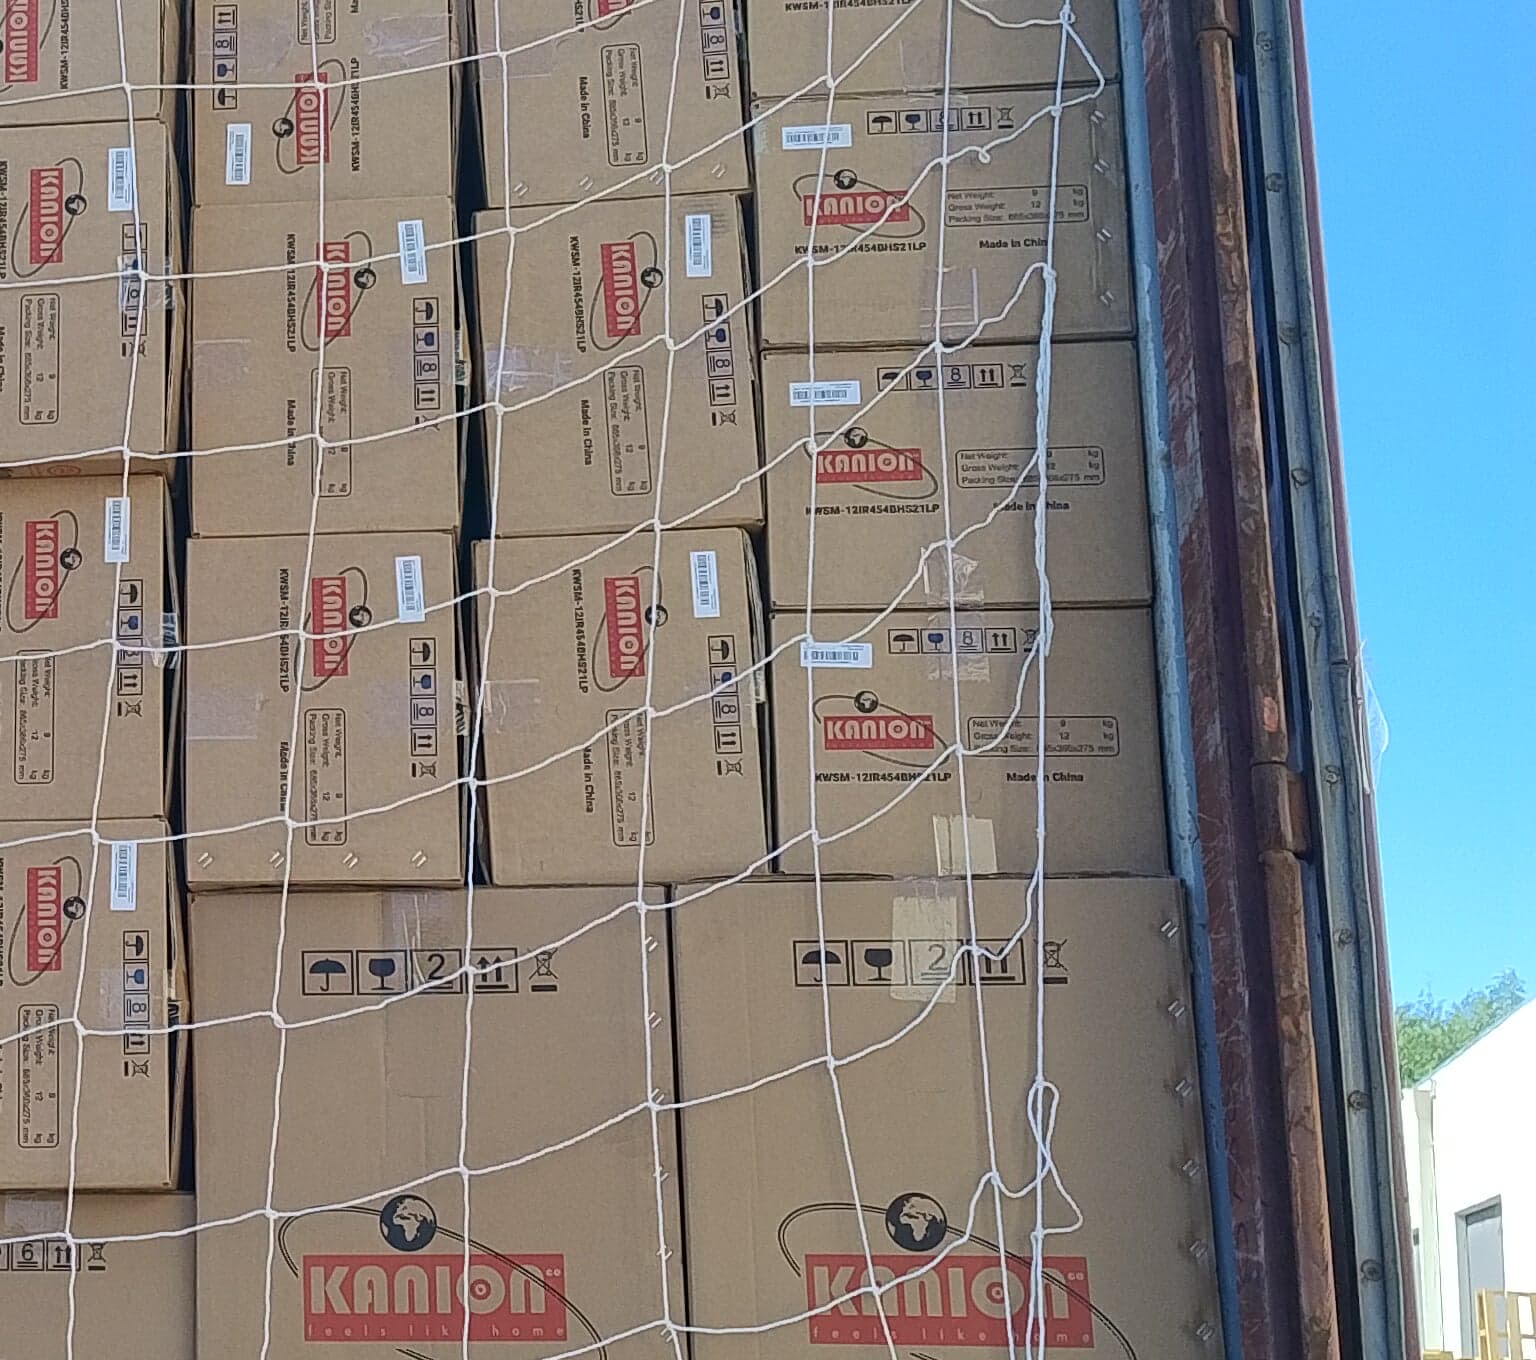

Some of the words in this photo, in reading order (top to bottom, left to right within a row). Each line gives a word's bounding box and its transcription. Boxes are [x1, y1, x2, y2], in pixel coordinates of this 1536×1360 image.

[9, 0, 29, 80] KANION
[39, 171, 59, 255] KANION
[610, 245, 636, 328] KANION
[820, 452, 913, 474] KANION
[34, 523, 54, 610] KANION
[321, 579, 343, 668] KANION
[614, 579, 640, 669] KANION
[827, 719, 924, 740] KANION
[37, 870, 57, 962] KANION
[310, 1264, 546, 1314] KANION
[492, 1325, 564, 1337] home
